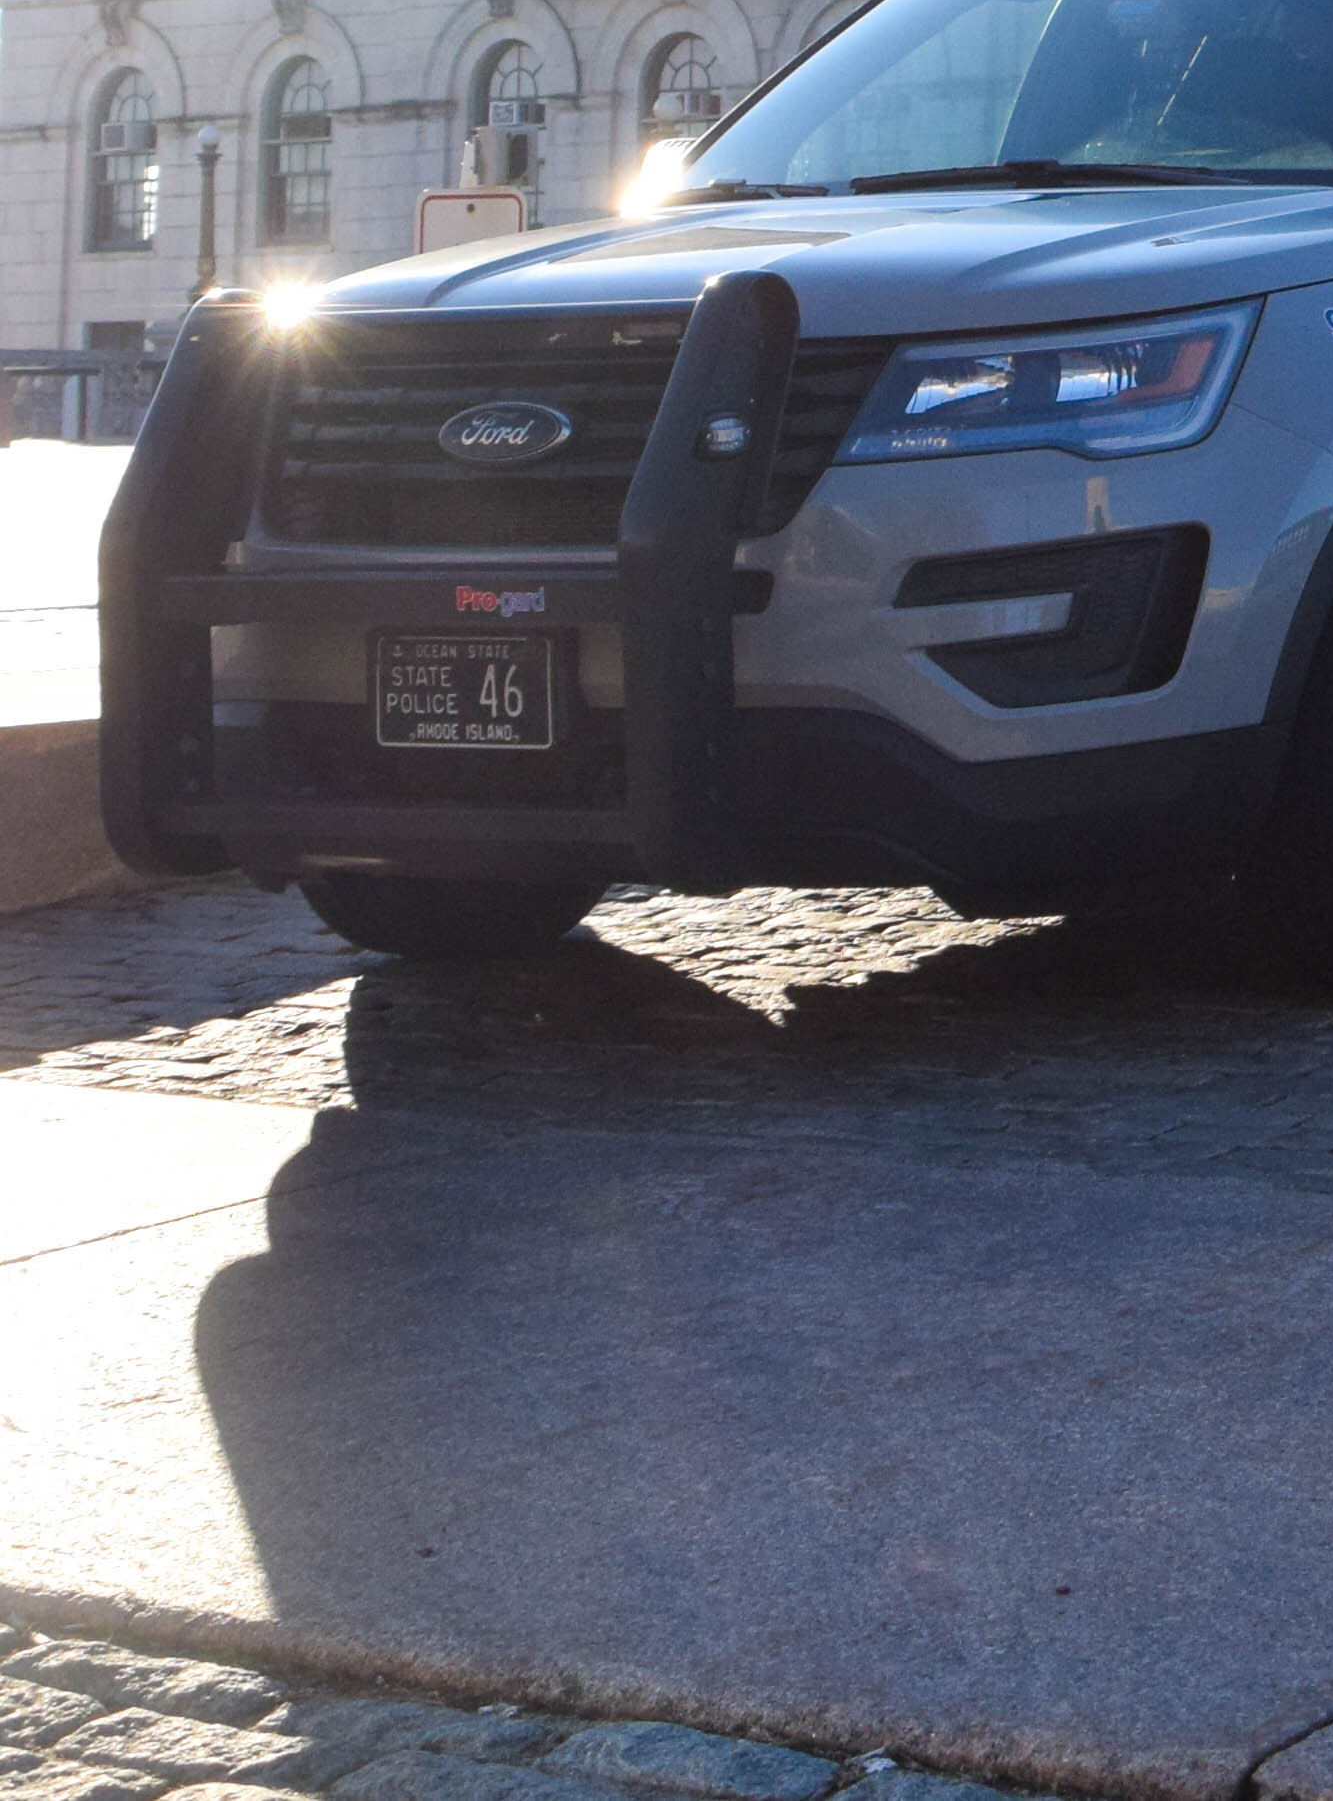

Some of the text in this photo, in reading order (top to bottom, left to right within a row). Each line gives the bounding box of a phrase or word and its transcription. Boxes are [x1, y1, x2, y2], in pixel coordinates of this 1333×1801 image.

[461, 414, 535, 446] Ford
[416, 644, 510, 659] OCEAN STATE
[392, 666, 452, 687] STATE
[480, 664, 523, 718] 46
[386, 693, 459, 714] POLICE
[417, 723, 512, 740] RHODE ISLAND
